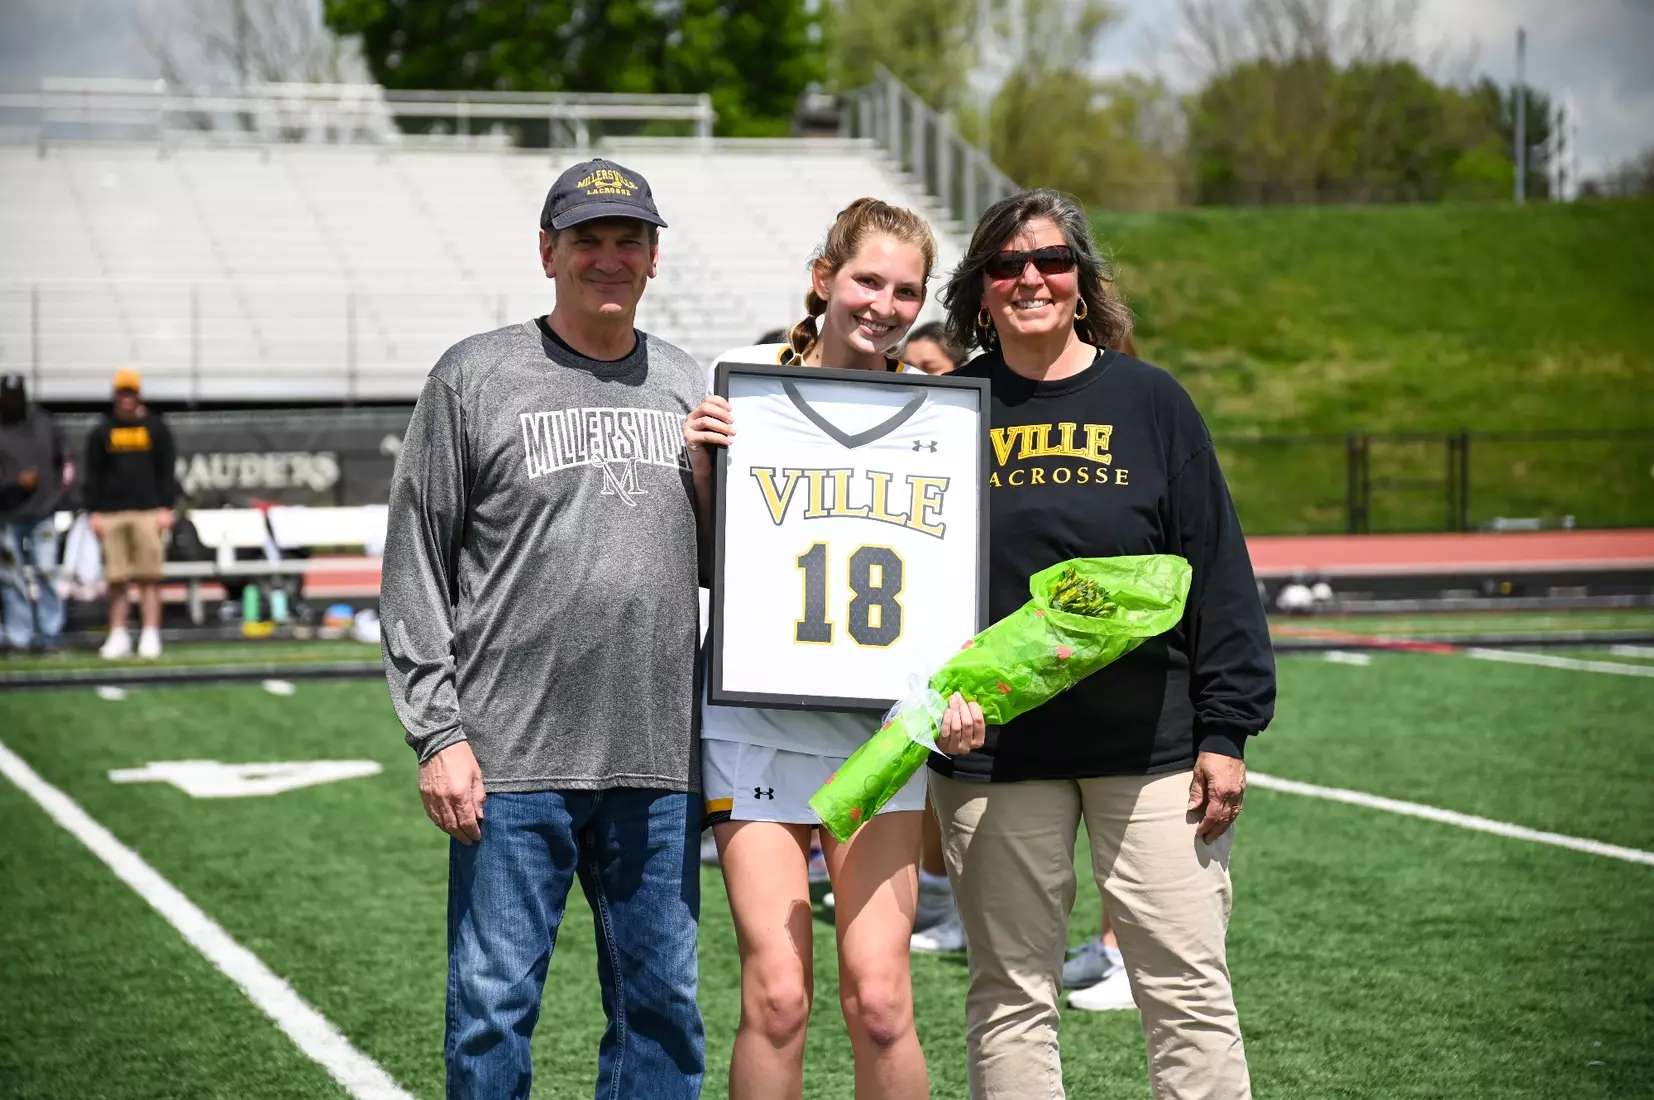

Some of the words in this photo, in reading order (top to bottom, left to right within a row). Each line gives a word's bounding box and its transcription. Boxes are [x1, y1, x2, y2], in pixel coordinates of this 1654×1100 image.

[576, 169, 638, 189] MILLERSVILLE
[586, 188, 631, 196] LACROSSE
[989, 422, 1113, 466] VILLE
[750, 466, 951, 540] VILLE
[793, 541, 905, 648] 18
